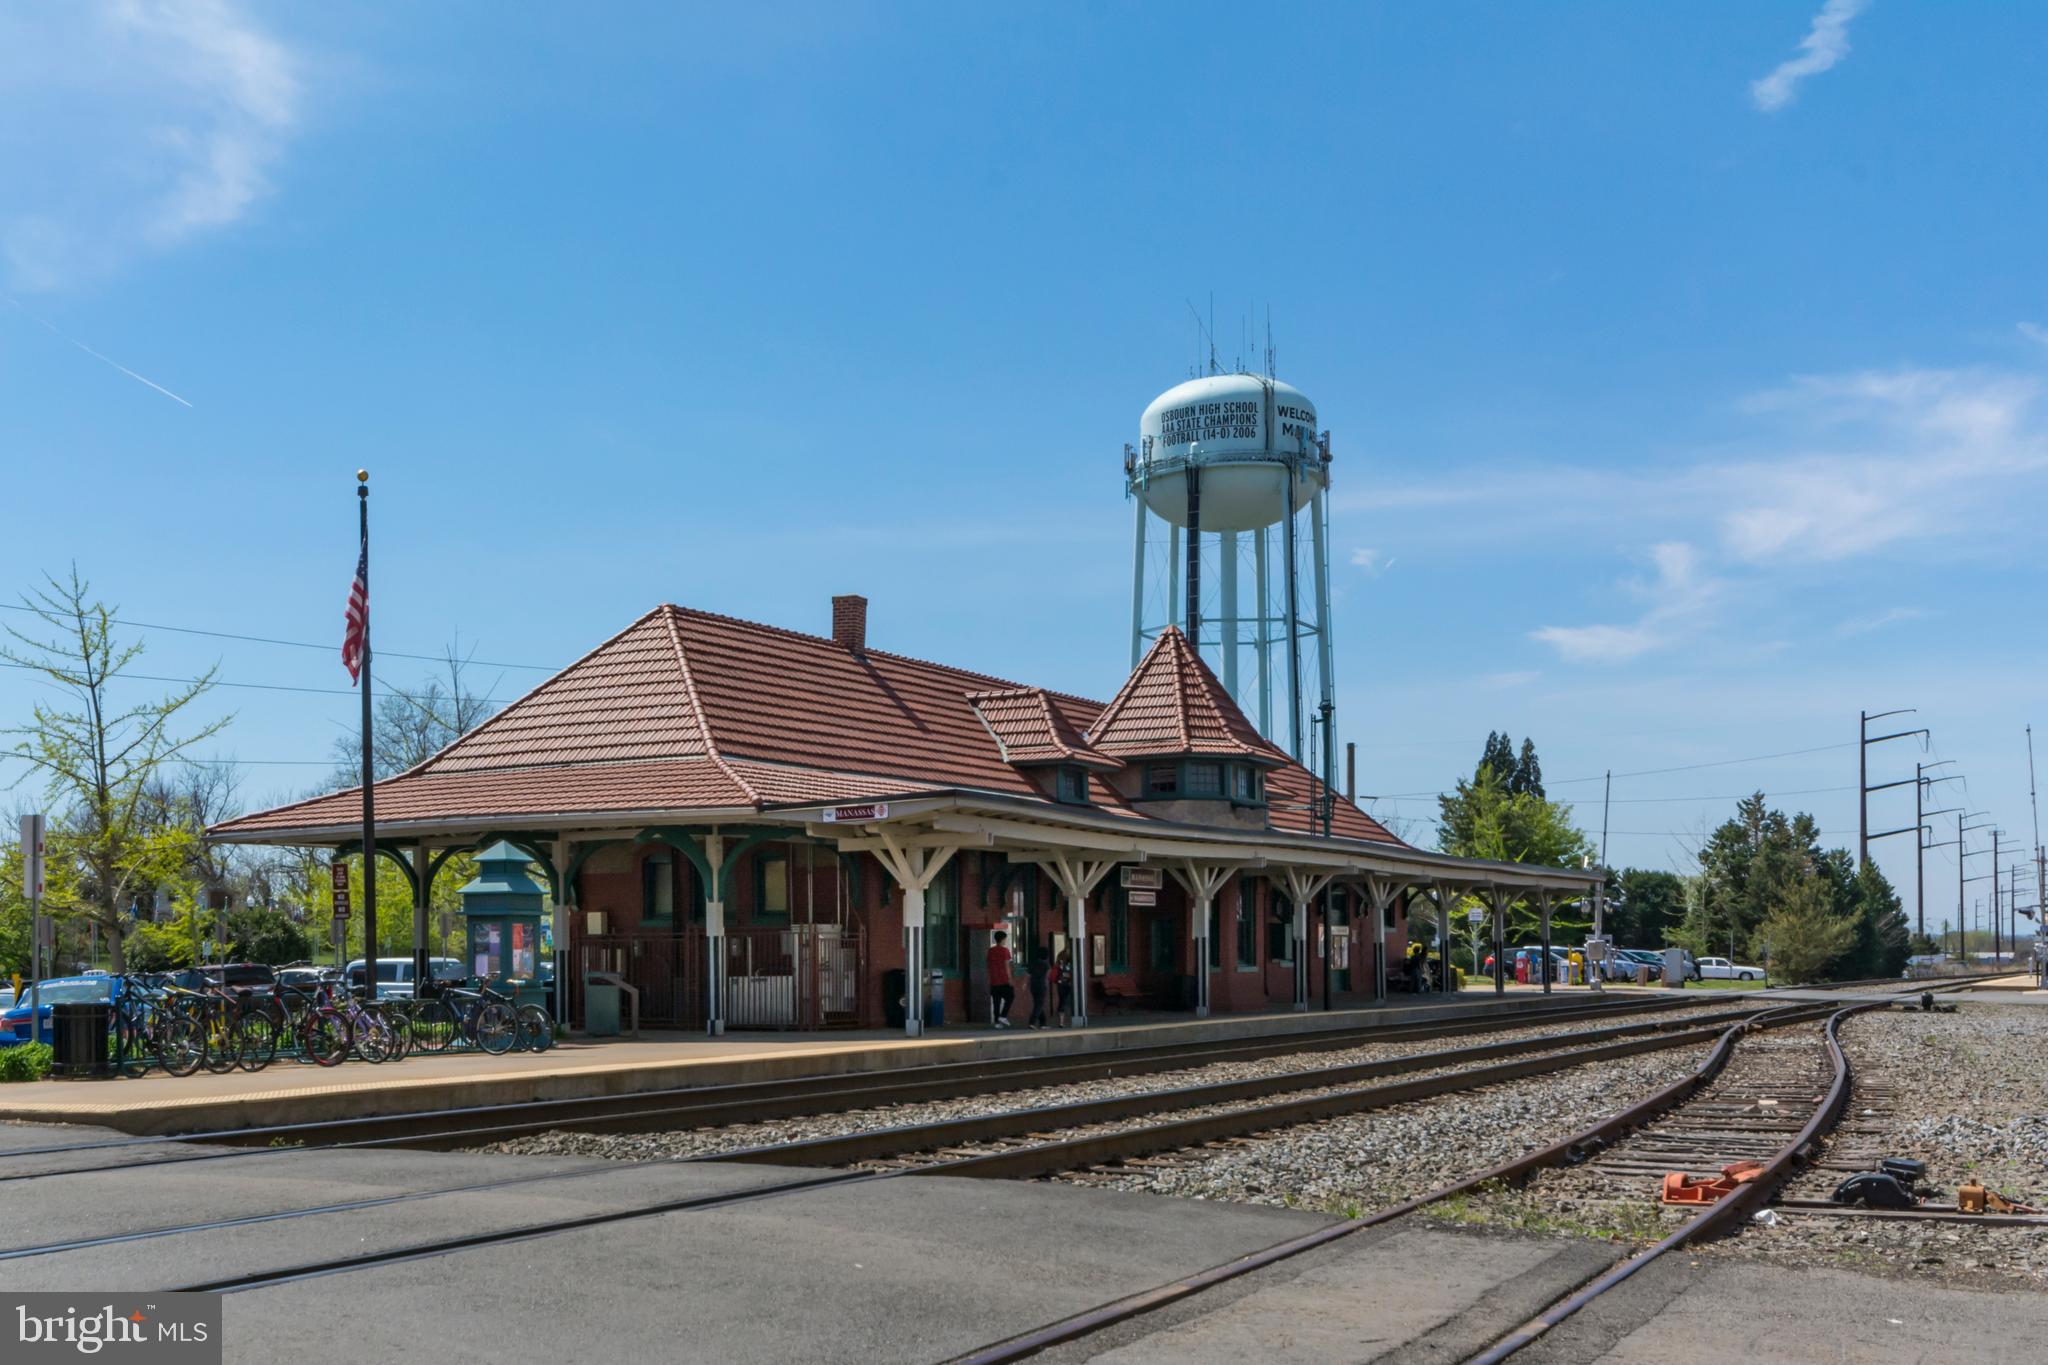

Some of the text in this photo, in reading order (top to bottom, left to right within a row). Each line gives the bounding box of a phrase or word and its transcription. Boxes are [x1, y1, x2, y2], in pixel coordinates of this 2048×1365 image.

[1161, 401, 1258, 423] OSBOURN HIGH SCHOOL
[1161, 413, 1257, 434] AAA STATE CHAMPIONS
[1162, 426, 1256, 447] FOOTBALL (14-0) 2006
[836, 808, 875, 818] MANASSAS
